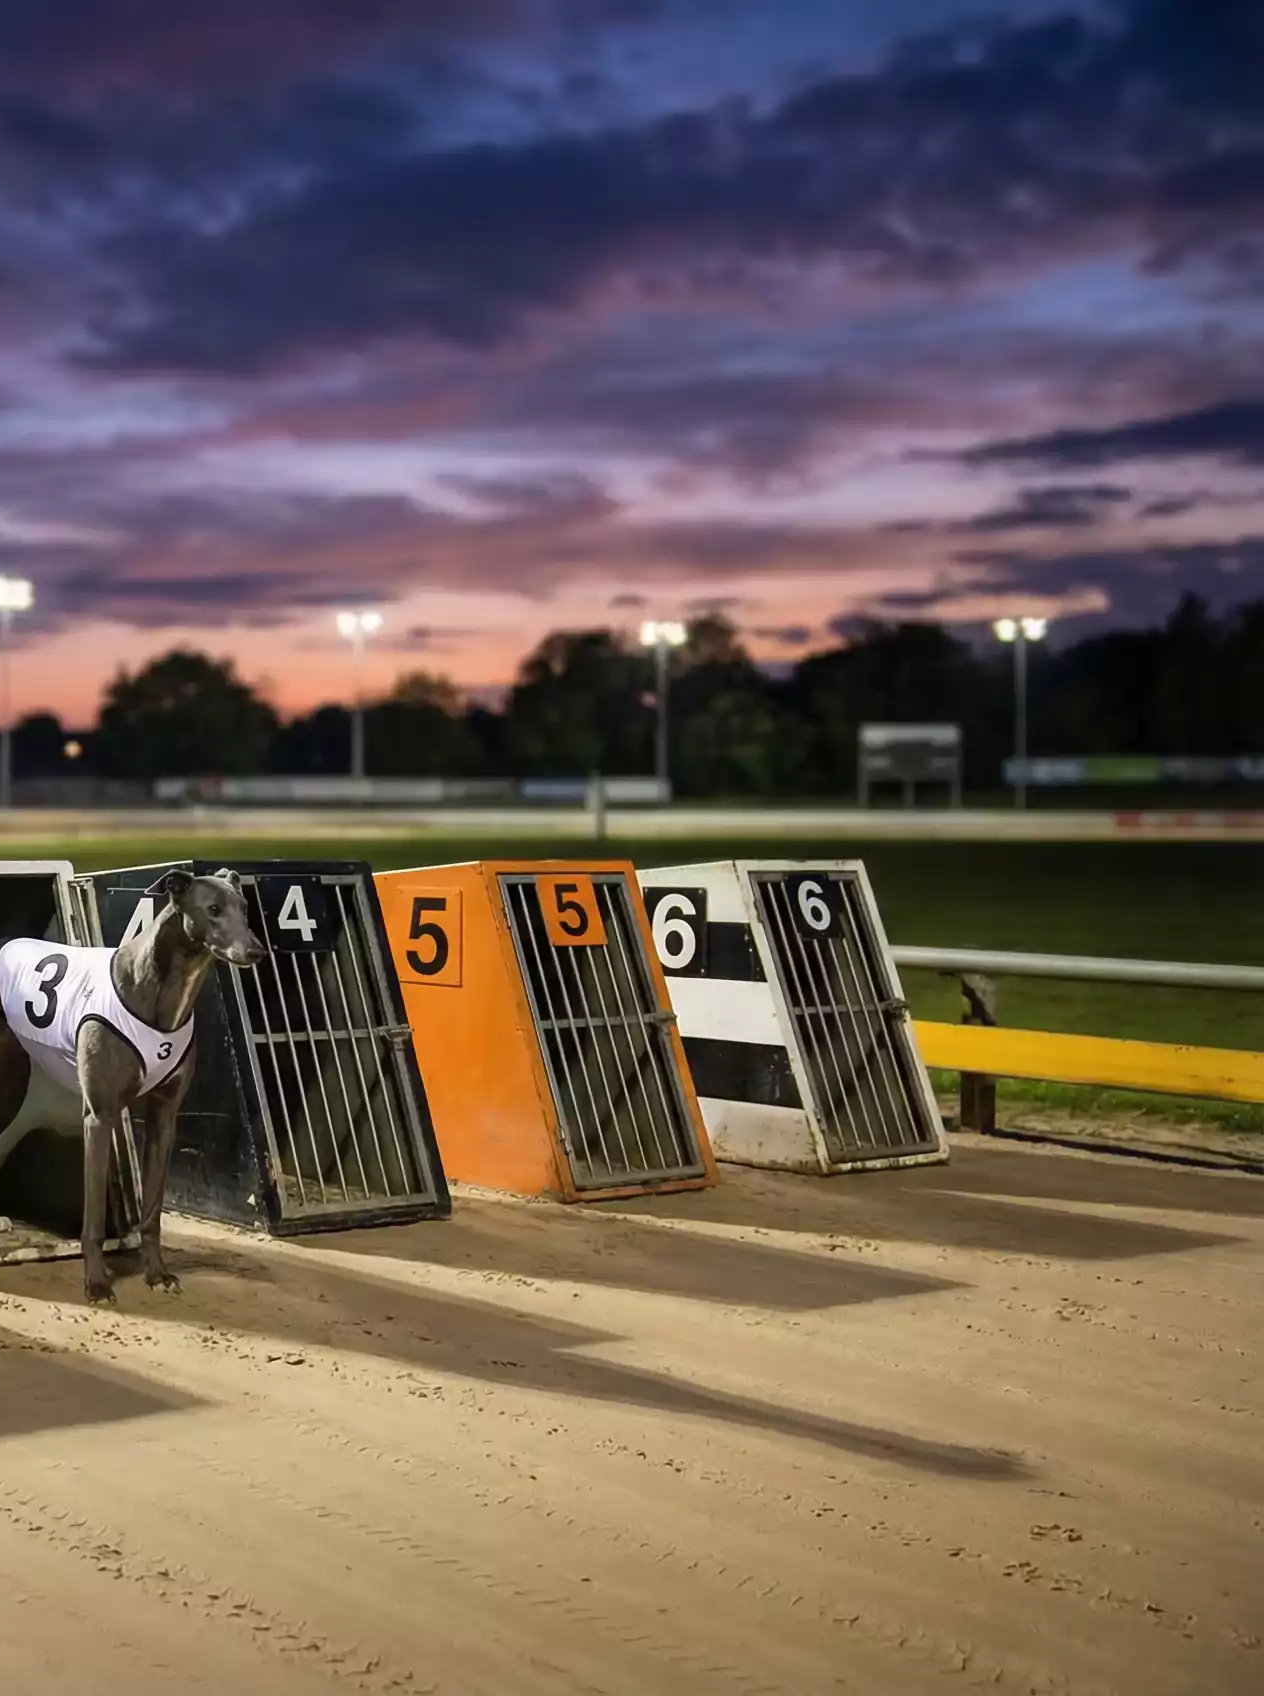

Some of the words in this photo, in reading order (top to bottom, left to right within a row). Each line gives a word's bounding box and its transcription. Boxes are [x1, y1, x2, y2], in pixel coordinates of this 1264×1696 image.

[278, 886, 317, 941] 4
[555, 884, 588, 936] 5
[652, 894, 696, 968] 6
[798, 881, 831, 931] 6
[407, 897, 448, 975] 5
[25, 954, 68, 1029] 3
[157, 1041, 173, 1060] 3
